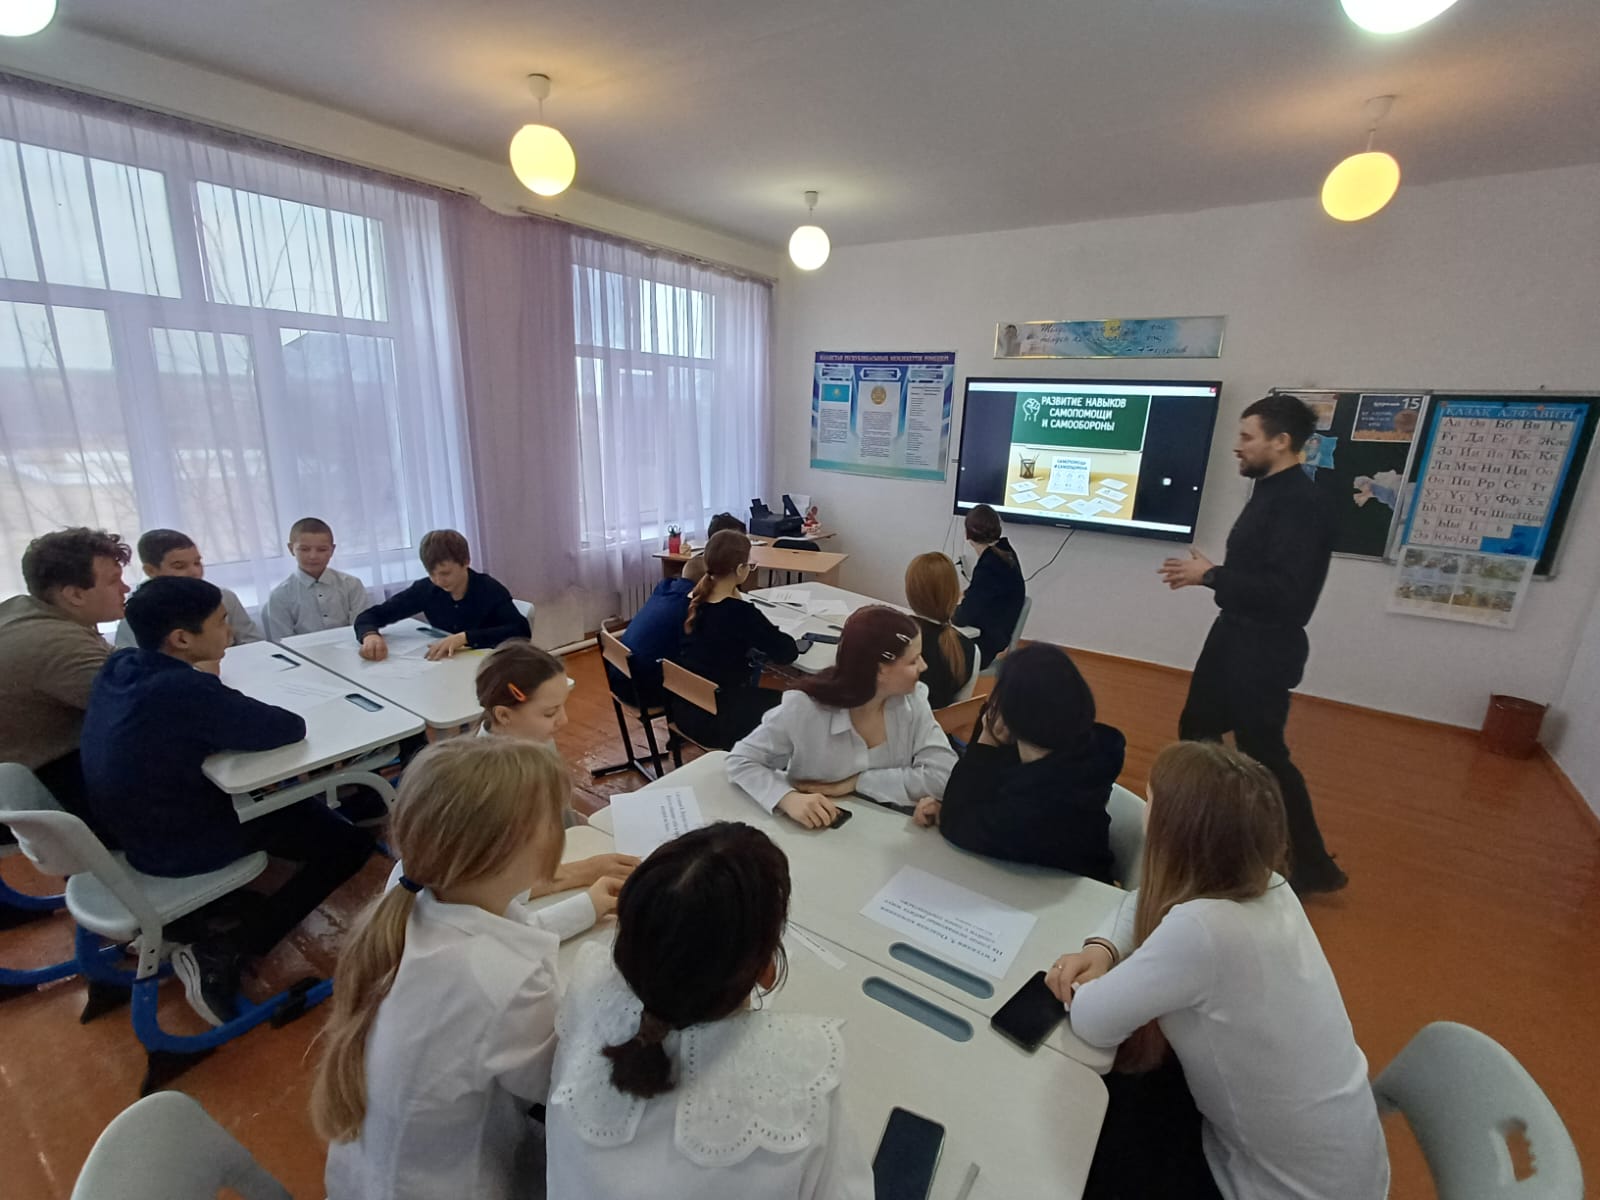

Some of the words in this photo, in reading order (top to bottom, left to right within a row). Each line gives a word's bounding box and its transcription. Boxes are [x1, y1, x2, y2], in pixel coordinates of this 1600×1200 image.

[1041, 396, 1083, 407] РАЗВИТИЕ
[1085, 398, 1127, 408] НАВЫКОВ
[1402, 397, 1421, 410] 15
[1049, 408, 1113, 419] САМОПОМОЩИ
[1041, 419, 1048, 428] И
[1050, 419, 1115, 431] САМООБОРОНЫ
[1495, 420, 1513, 428] Бб
[1478, 479, 1495, 488] Рр
[1496, 494, 1520, 506] Фф
